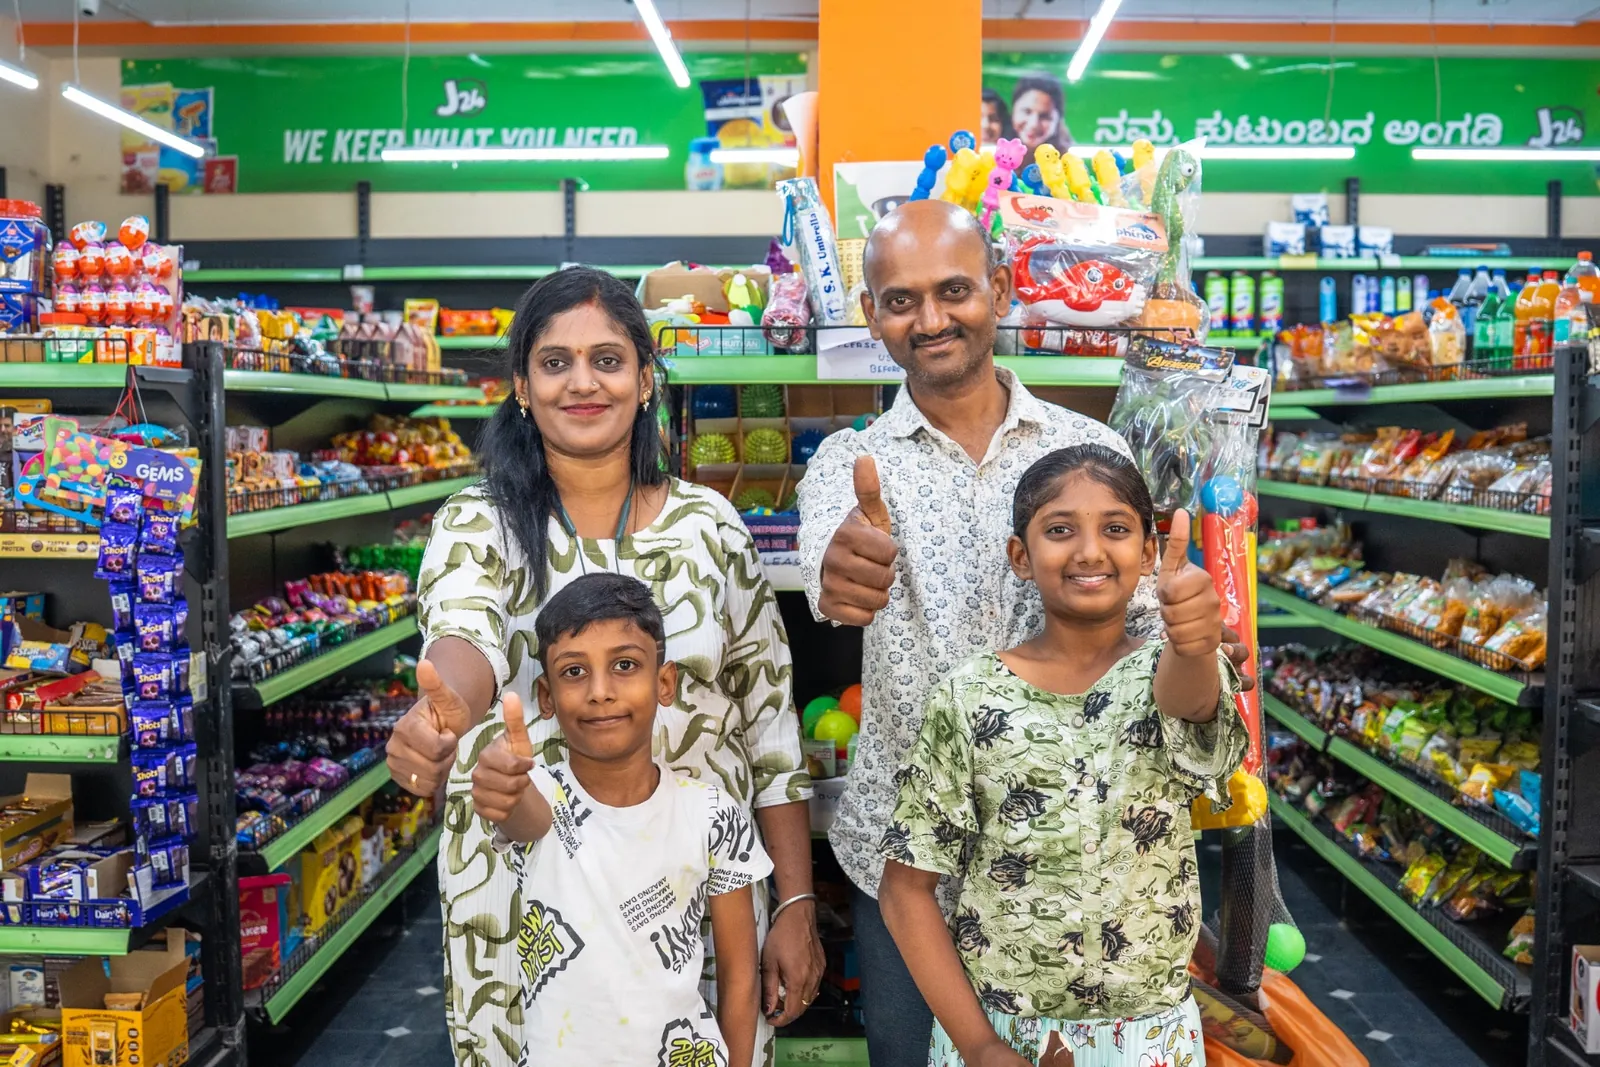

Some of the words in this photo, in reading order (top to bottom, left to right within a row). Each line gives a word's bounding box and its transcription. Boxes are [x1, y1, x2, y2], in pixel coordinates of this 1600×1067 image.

[283, 129, 328, 163] WE
[810, 212, 828, 260] Umbrella
[838, 341, 877, 349] LEASE
[136, 463, 184, 483] GEMS
[763, 557, 801, 566] LEAS
[733, 871, 753, 880] DAYS
[637, 876, 667, 900] AMAZING
[641, 883, 671, 907] AMAZING
[619, 898, 638, 911] DAYS
[622, 903, 641, 919] DAYS
[645, 890, 674, 914] AMAZING
[649, 896, 677, 920] AMAZING
[627, 911, 645, 926] DAYS
[631, 917, 650, 933] DAYS
[517, 904, 544, 958] NEW
